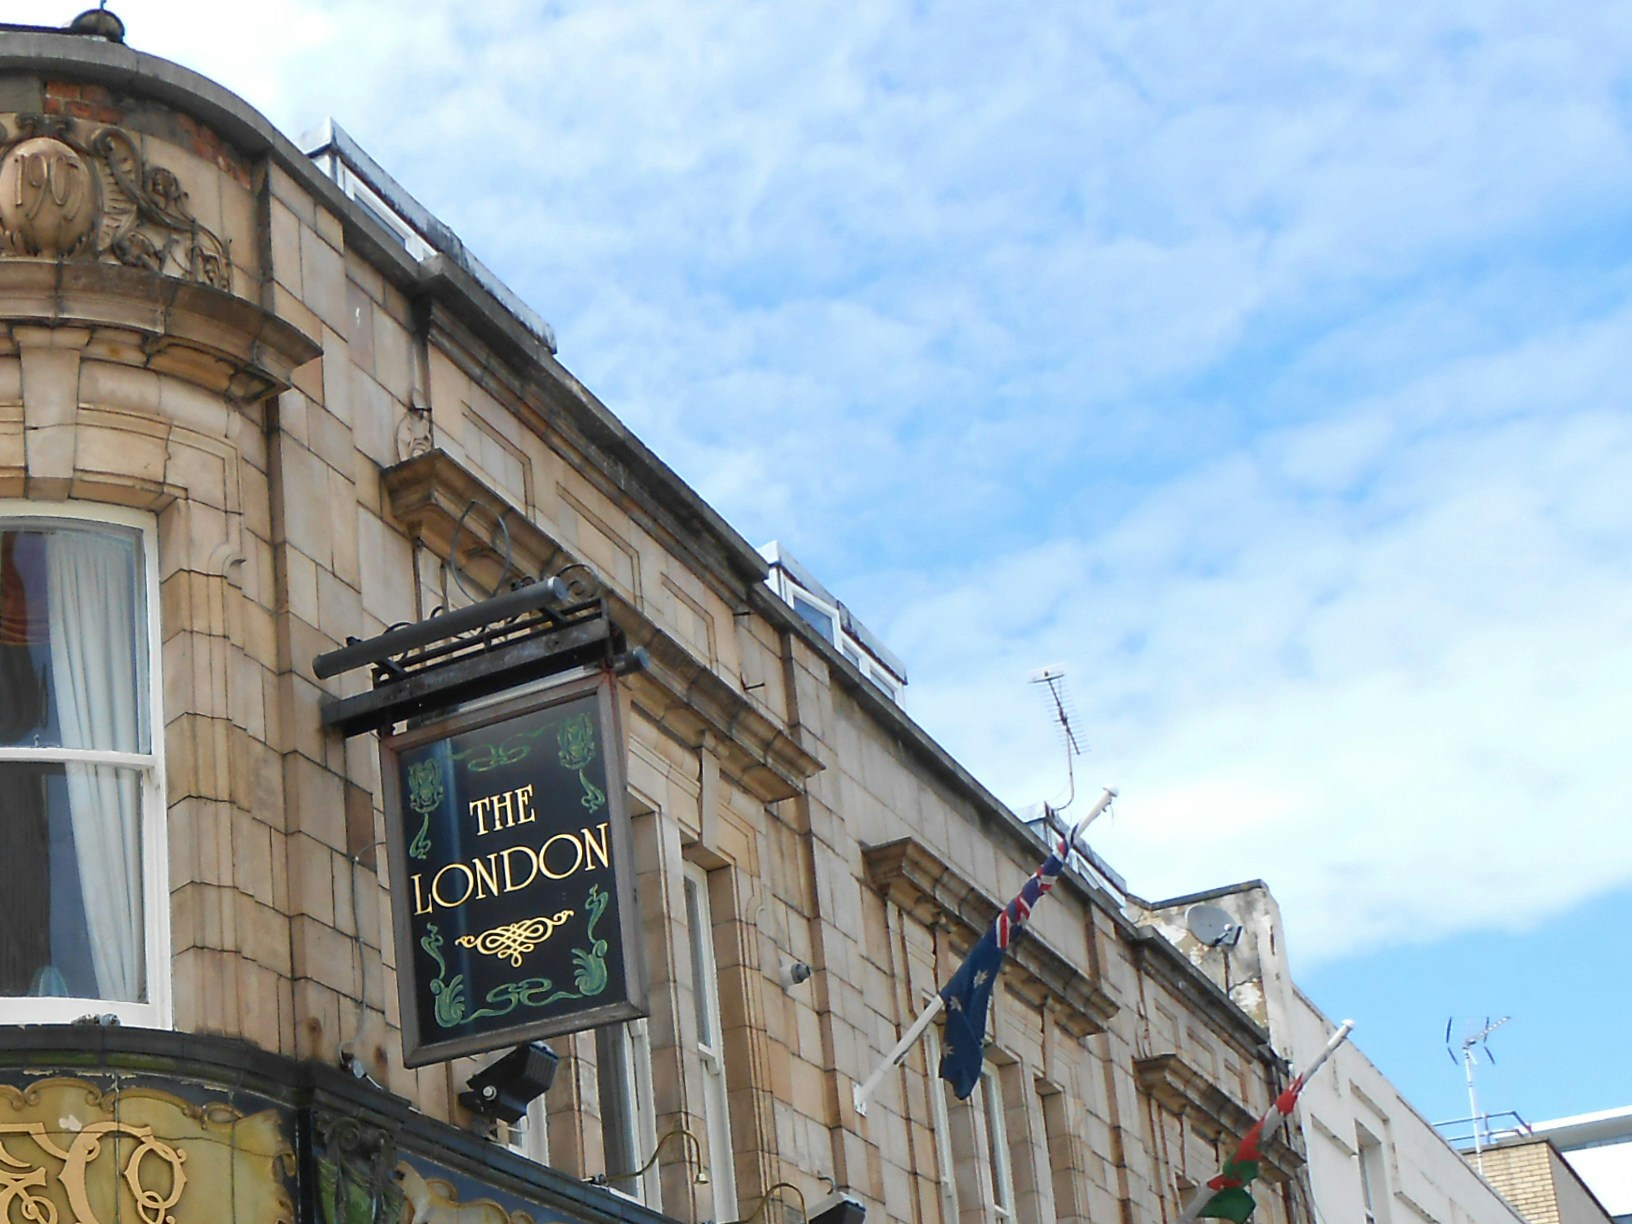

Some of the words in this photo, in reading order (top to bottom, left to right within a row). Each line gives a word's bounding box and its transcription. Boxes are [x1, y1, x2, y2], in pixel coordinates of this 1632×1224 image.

[14, 153, 84, 222] 1907
[468, 783, 536, 836] THE
[410, 823, 610, 916] LONDON
